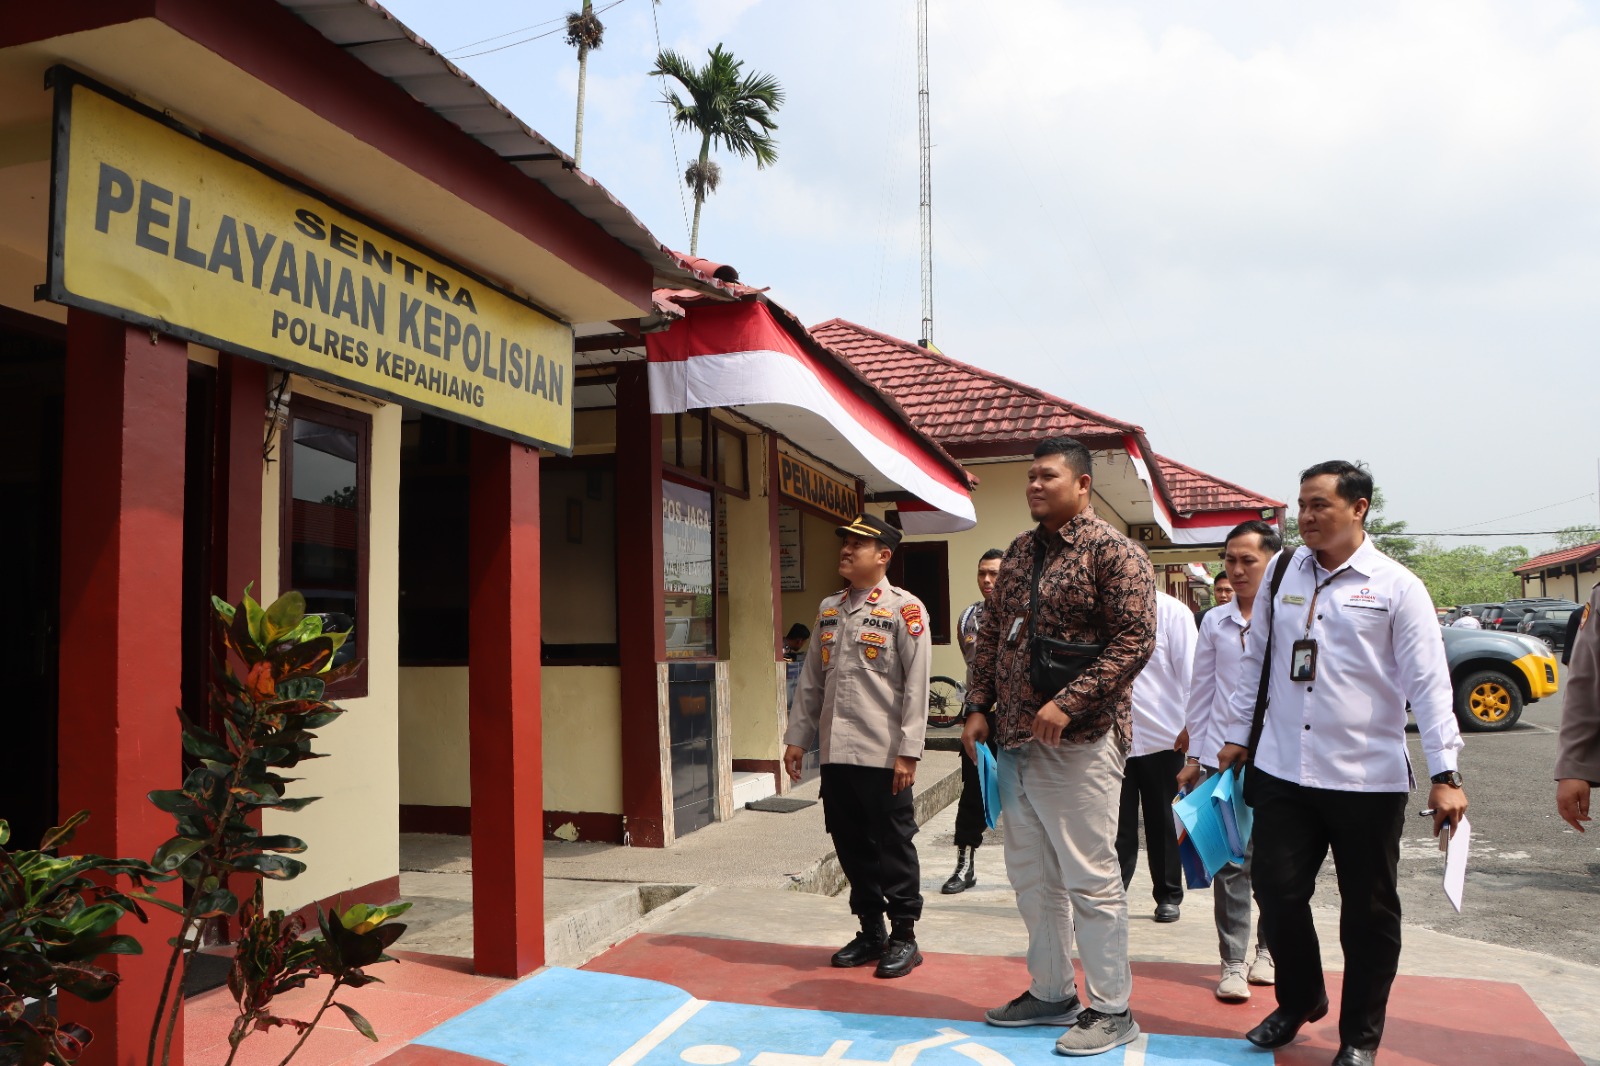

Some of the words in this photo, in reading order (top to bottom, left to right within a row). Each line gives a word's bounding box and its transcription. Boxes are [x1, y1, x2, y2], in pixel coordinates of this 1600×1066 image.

[94, 162, 387, 335] PELAYANAN
[399, 297, 564, 406] KEPOLISIAN
[294, 208, 478, 314] SENTRA
[271, 309, 369, 368] POLRES
[376, 349, 485, 408] KEPAHIANG
[663, 498, 681, 523] POS
[685, 505, 710, 530] JAGA
[781, 458, 857, 520] PENJAGAAN
[862, 618, 893, 629] POLRI
